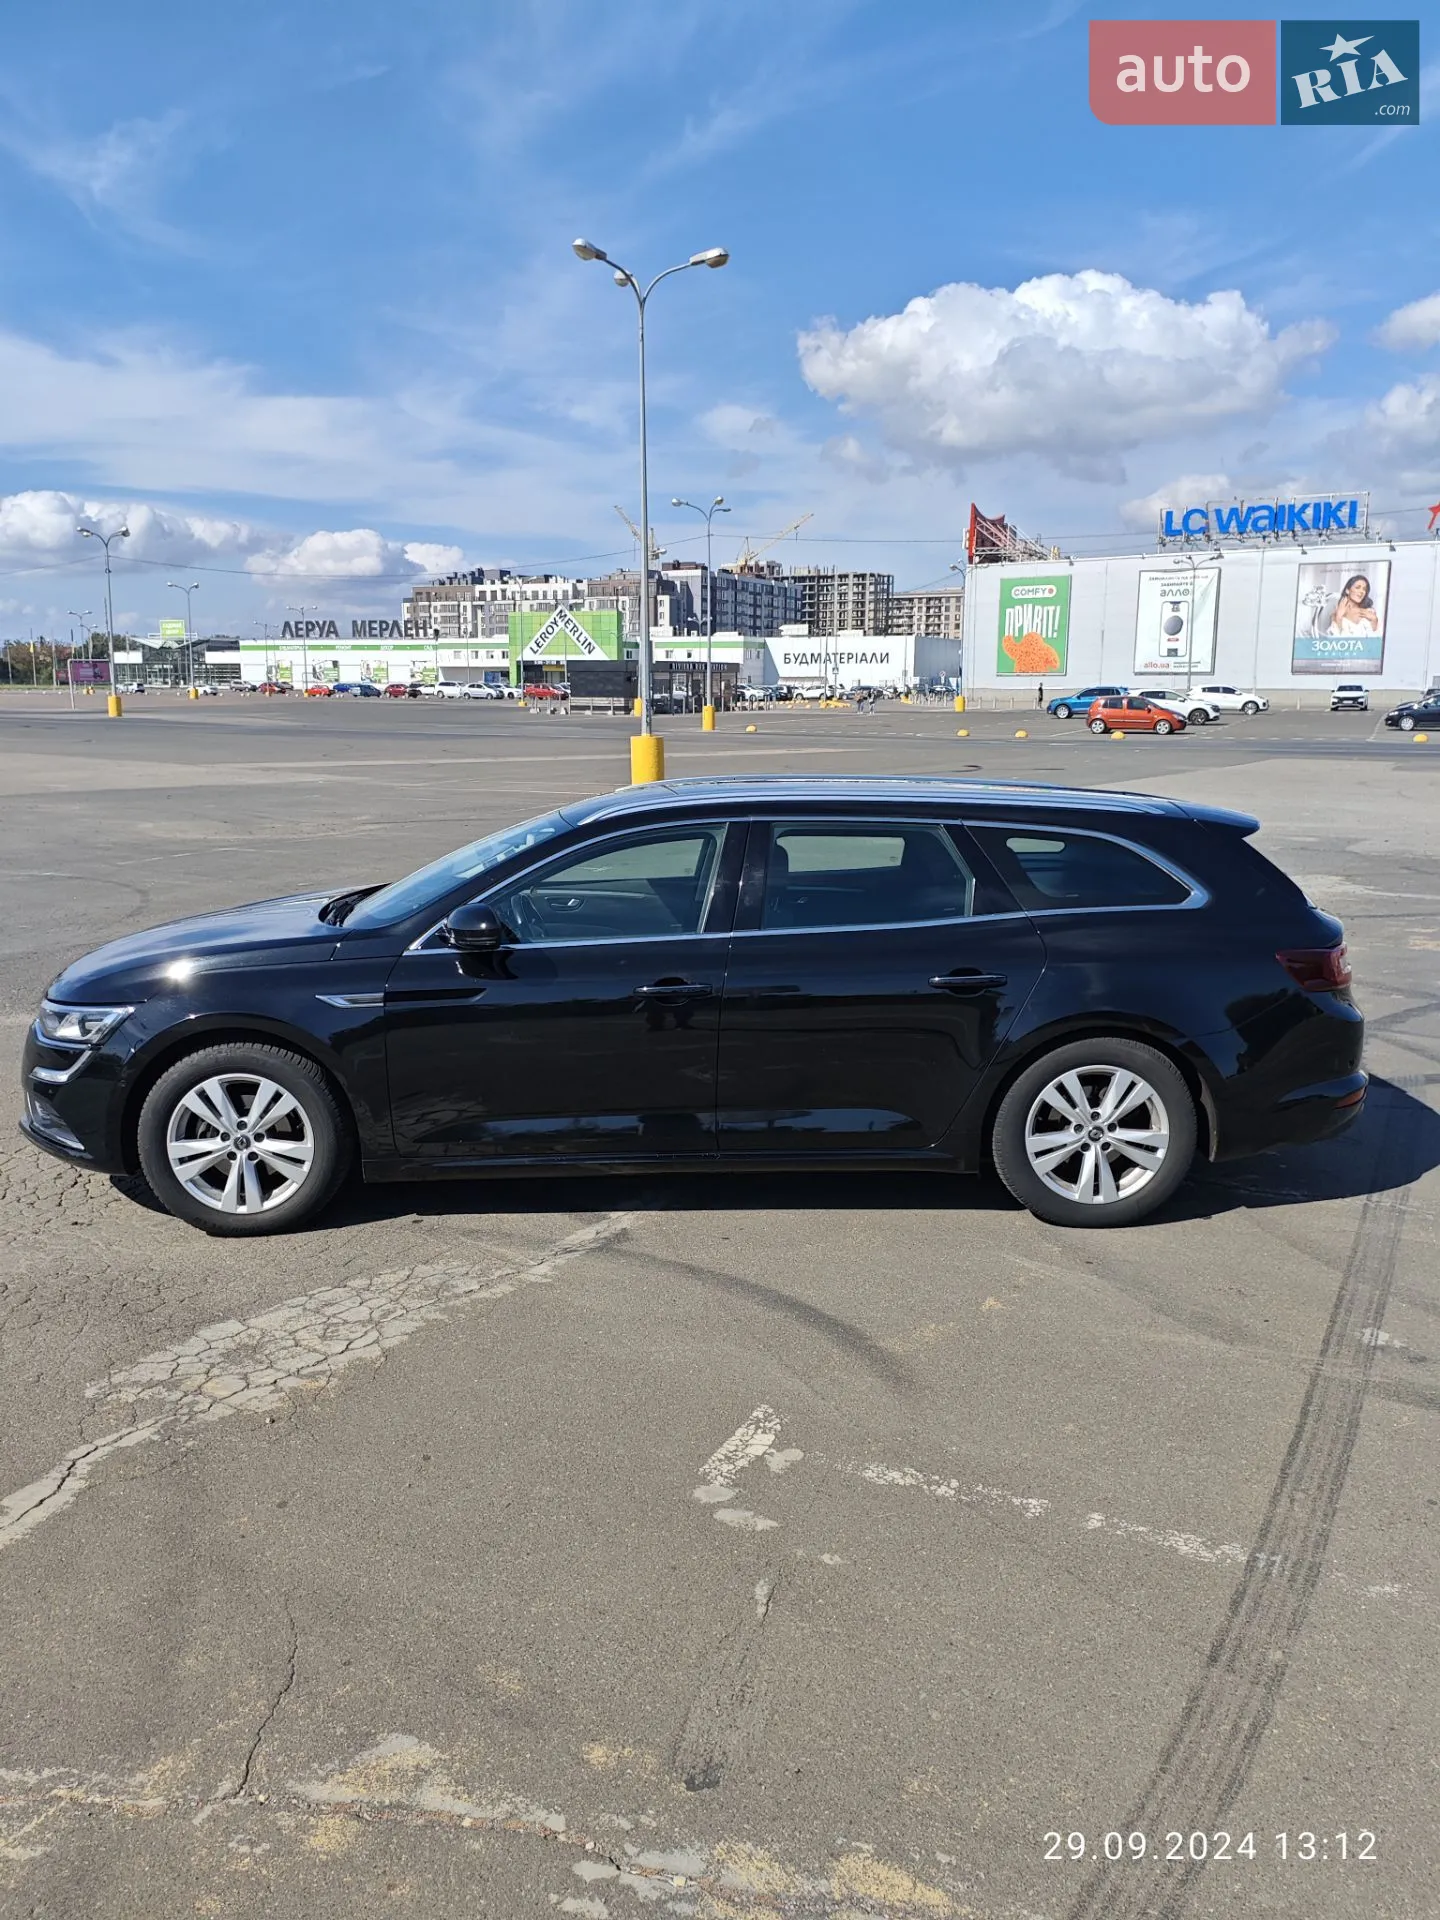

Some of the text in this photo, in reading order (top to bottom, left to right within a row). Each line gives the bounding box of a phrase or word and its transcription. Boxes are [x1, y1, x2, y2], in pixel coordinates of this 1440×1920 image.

[1164, 508, 1209, 537] LC
[1013, 587, 1047, 597] COMFY
[281, 619, 428, 639] ЛЕРУА МЕРЛЕН
[556, 609, 596, 655] MERLIN
[1004, 603, 1061, 638] ПРИВІТ!
[529, 617, 560, 655] LEROY
[1311, 640, 1364, 652] ЗОЛОТА
[783, 652, 890, 666] БУДМАТЕРІАЛИ
